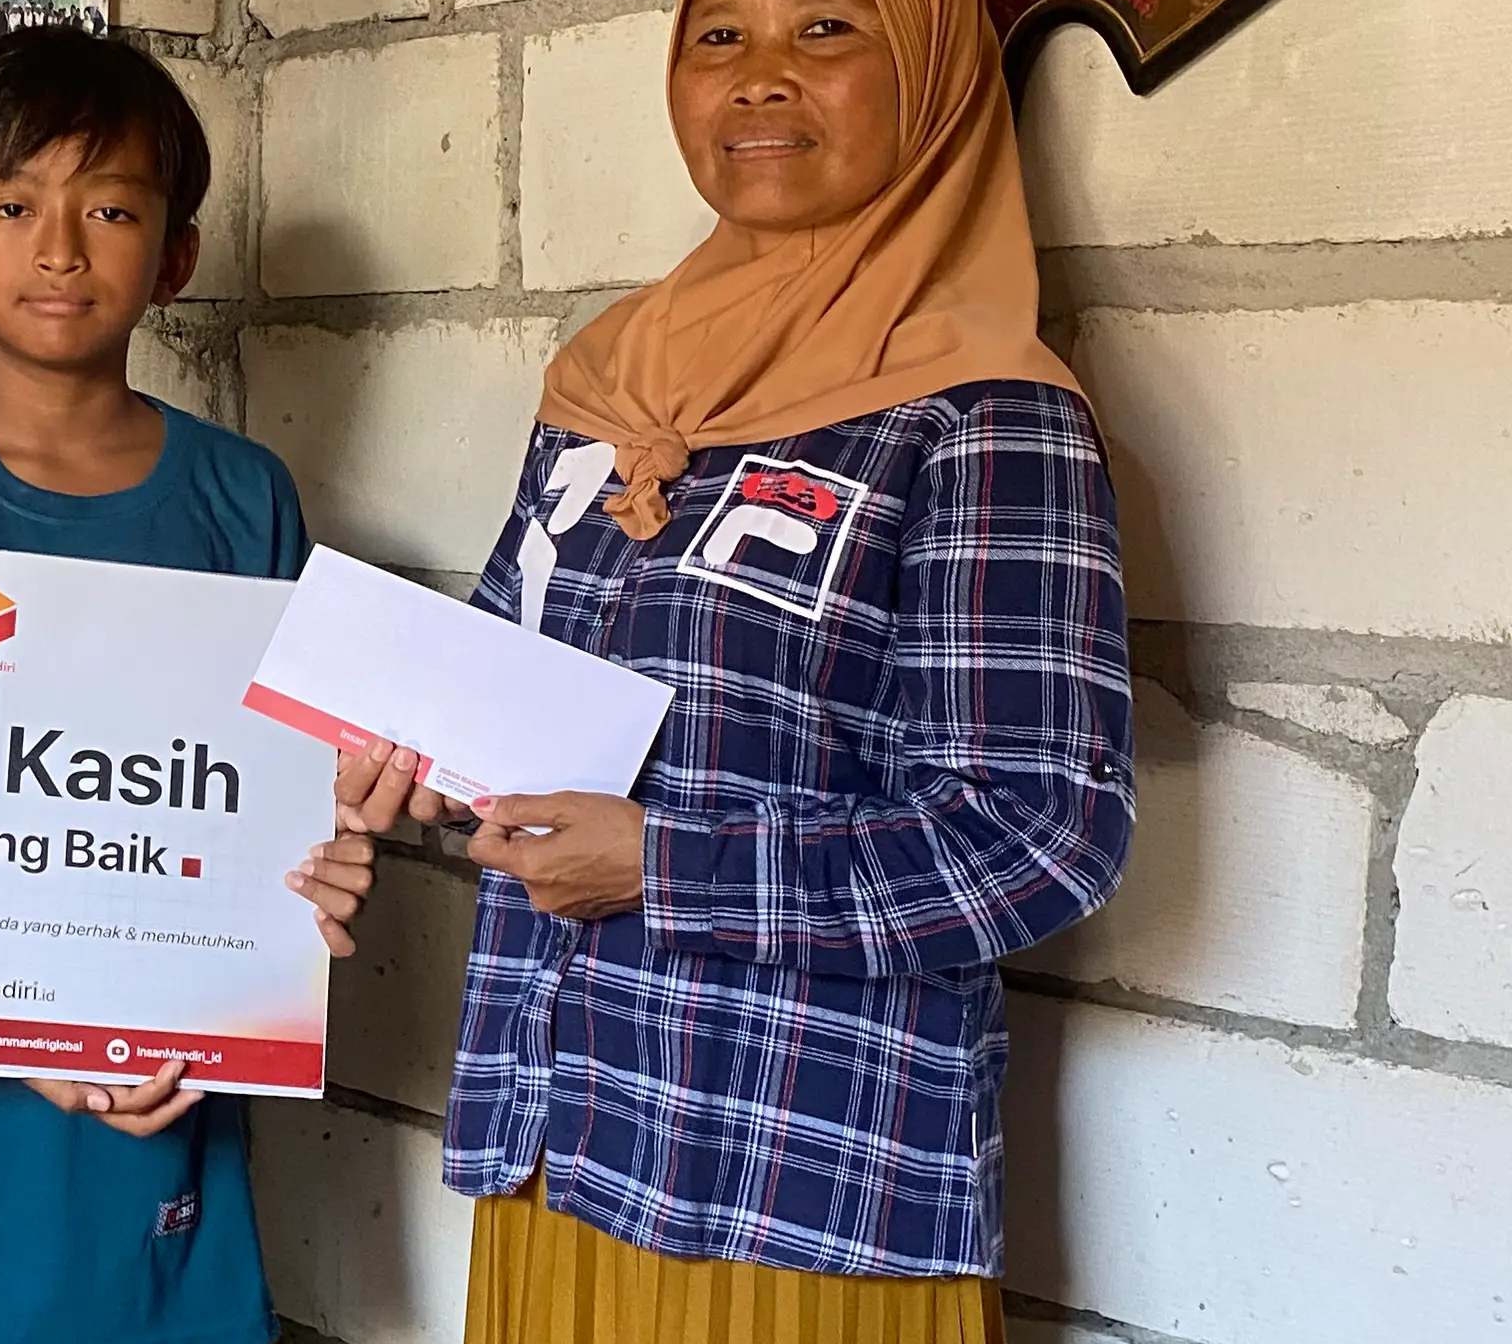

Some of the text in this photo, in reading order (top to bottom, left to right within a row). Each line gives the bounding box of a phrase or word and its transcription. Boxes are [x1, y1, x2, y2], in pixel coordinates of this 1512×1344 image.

[340, 728, 368, 748] Insan
[6, 726, 241, 814] Kasih
[65, 829, 168, 876] Baik
[21, 921, 62, 937] yang
[65, 921, 121, 939] berhak
[125, 927, 138, 940] &
[141, 930, 259, 951] membutuhkan.
[136, 1045, 222, 1064] InsanMandiri_id
